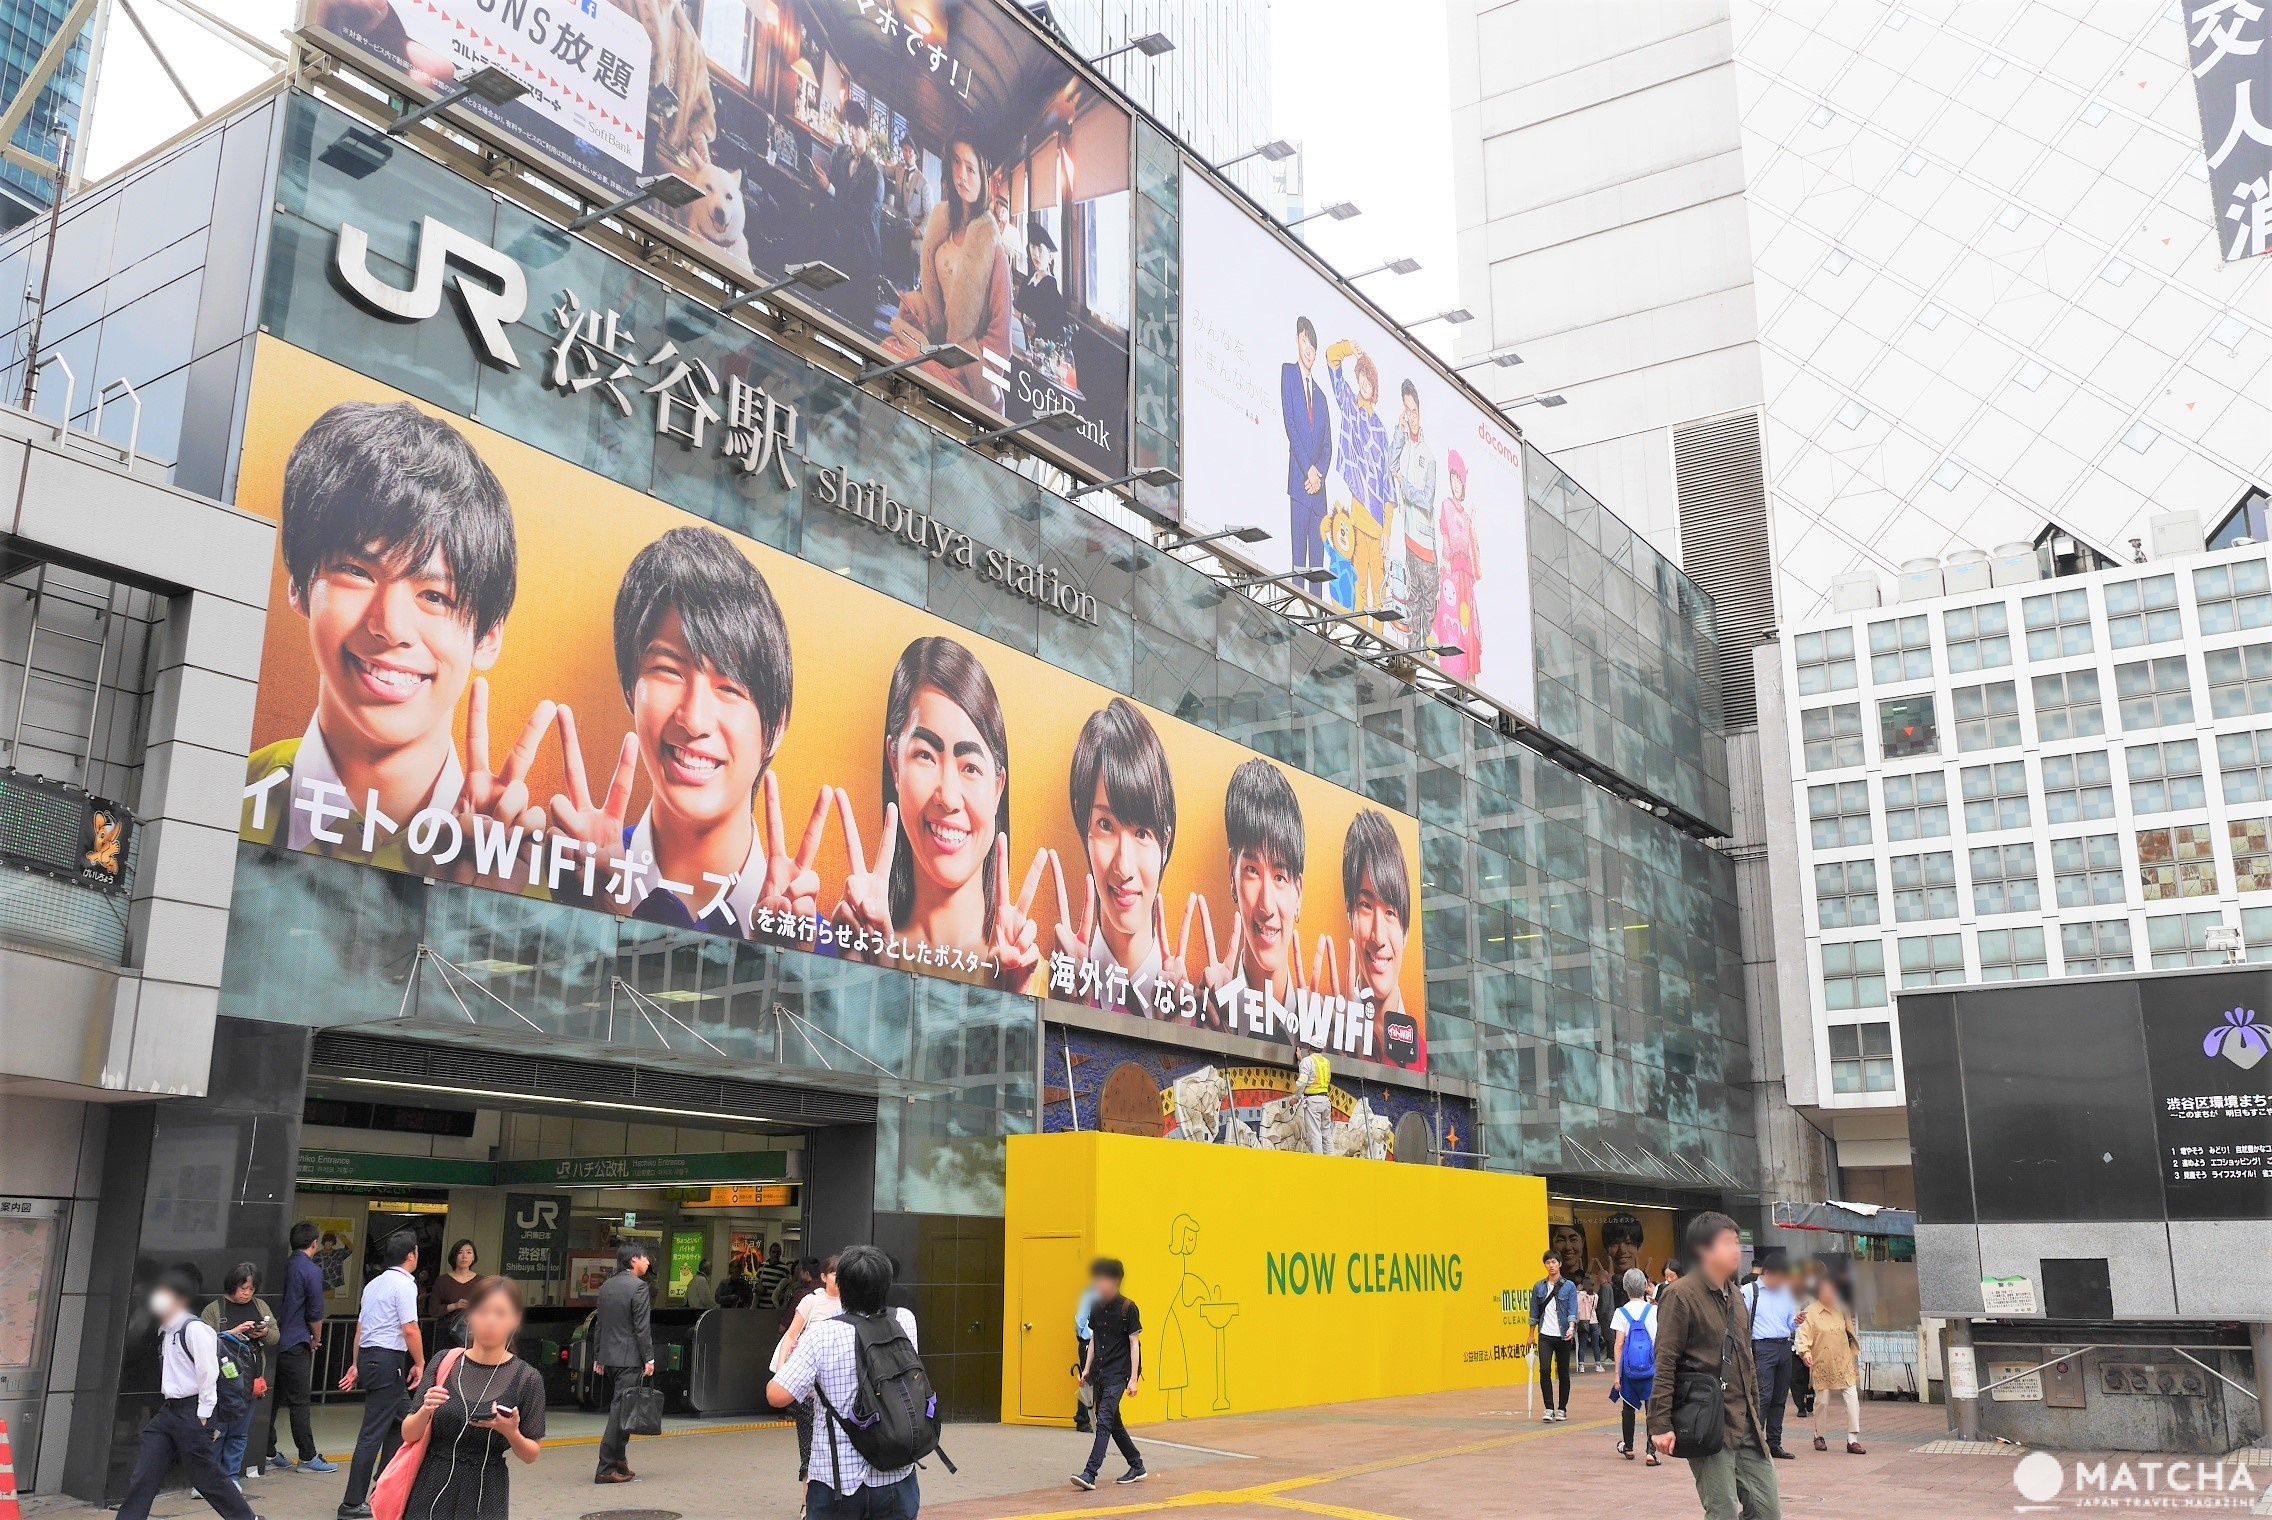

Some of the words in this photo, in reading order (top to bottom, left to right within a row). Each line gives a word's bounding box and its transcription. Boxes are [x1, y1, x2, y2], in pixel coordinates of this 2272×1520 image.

[588, 121, 632, 156] SoftBank
[336, 214, 528, 371] JR
[551, 287, 799, 491] 渋谷駅
[1478, 422, 1519, 468] docomo
[818, 465, 974, 568] shibuya
[986, 548, 1099, 627] station
[317, 1155, 351, 1165] Entrance
[572, 1159, 629, 1178] ハチ公改札
[2172, 1159, 2179, 1168] 2
[2174, 1171, 2180, 1180] 3
[0, 1201, 32, 1213] 案内図
[516, 1200, 559, 1230] JR
[506, 1262, 535, 1273] Shibuya
[536, 1263, 561, 1272] Stion
[1266, 1250, 1337, 1296] NOW
[1346, 1252, 1464, 1295] CLEANING
[1502, 1315, 1526, 1325] CLEAN
[1493, 1343, 1539, 1361] 日本交通文
